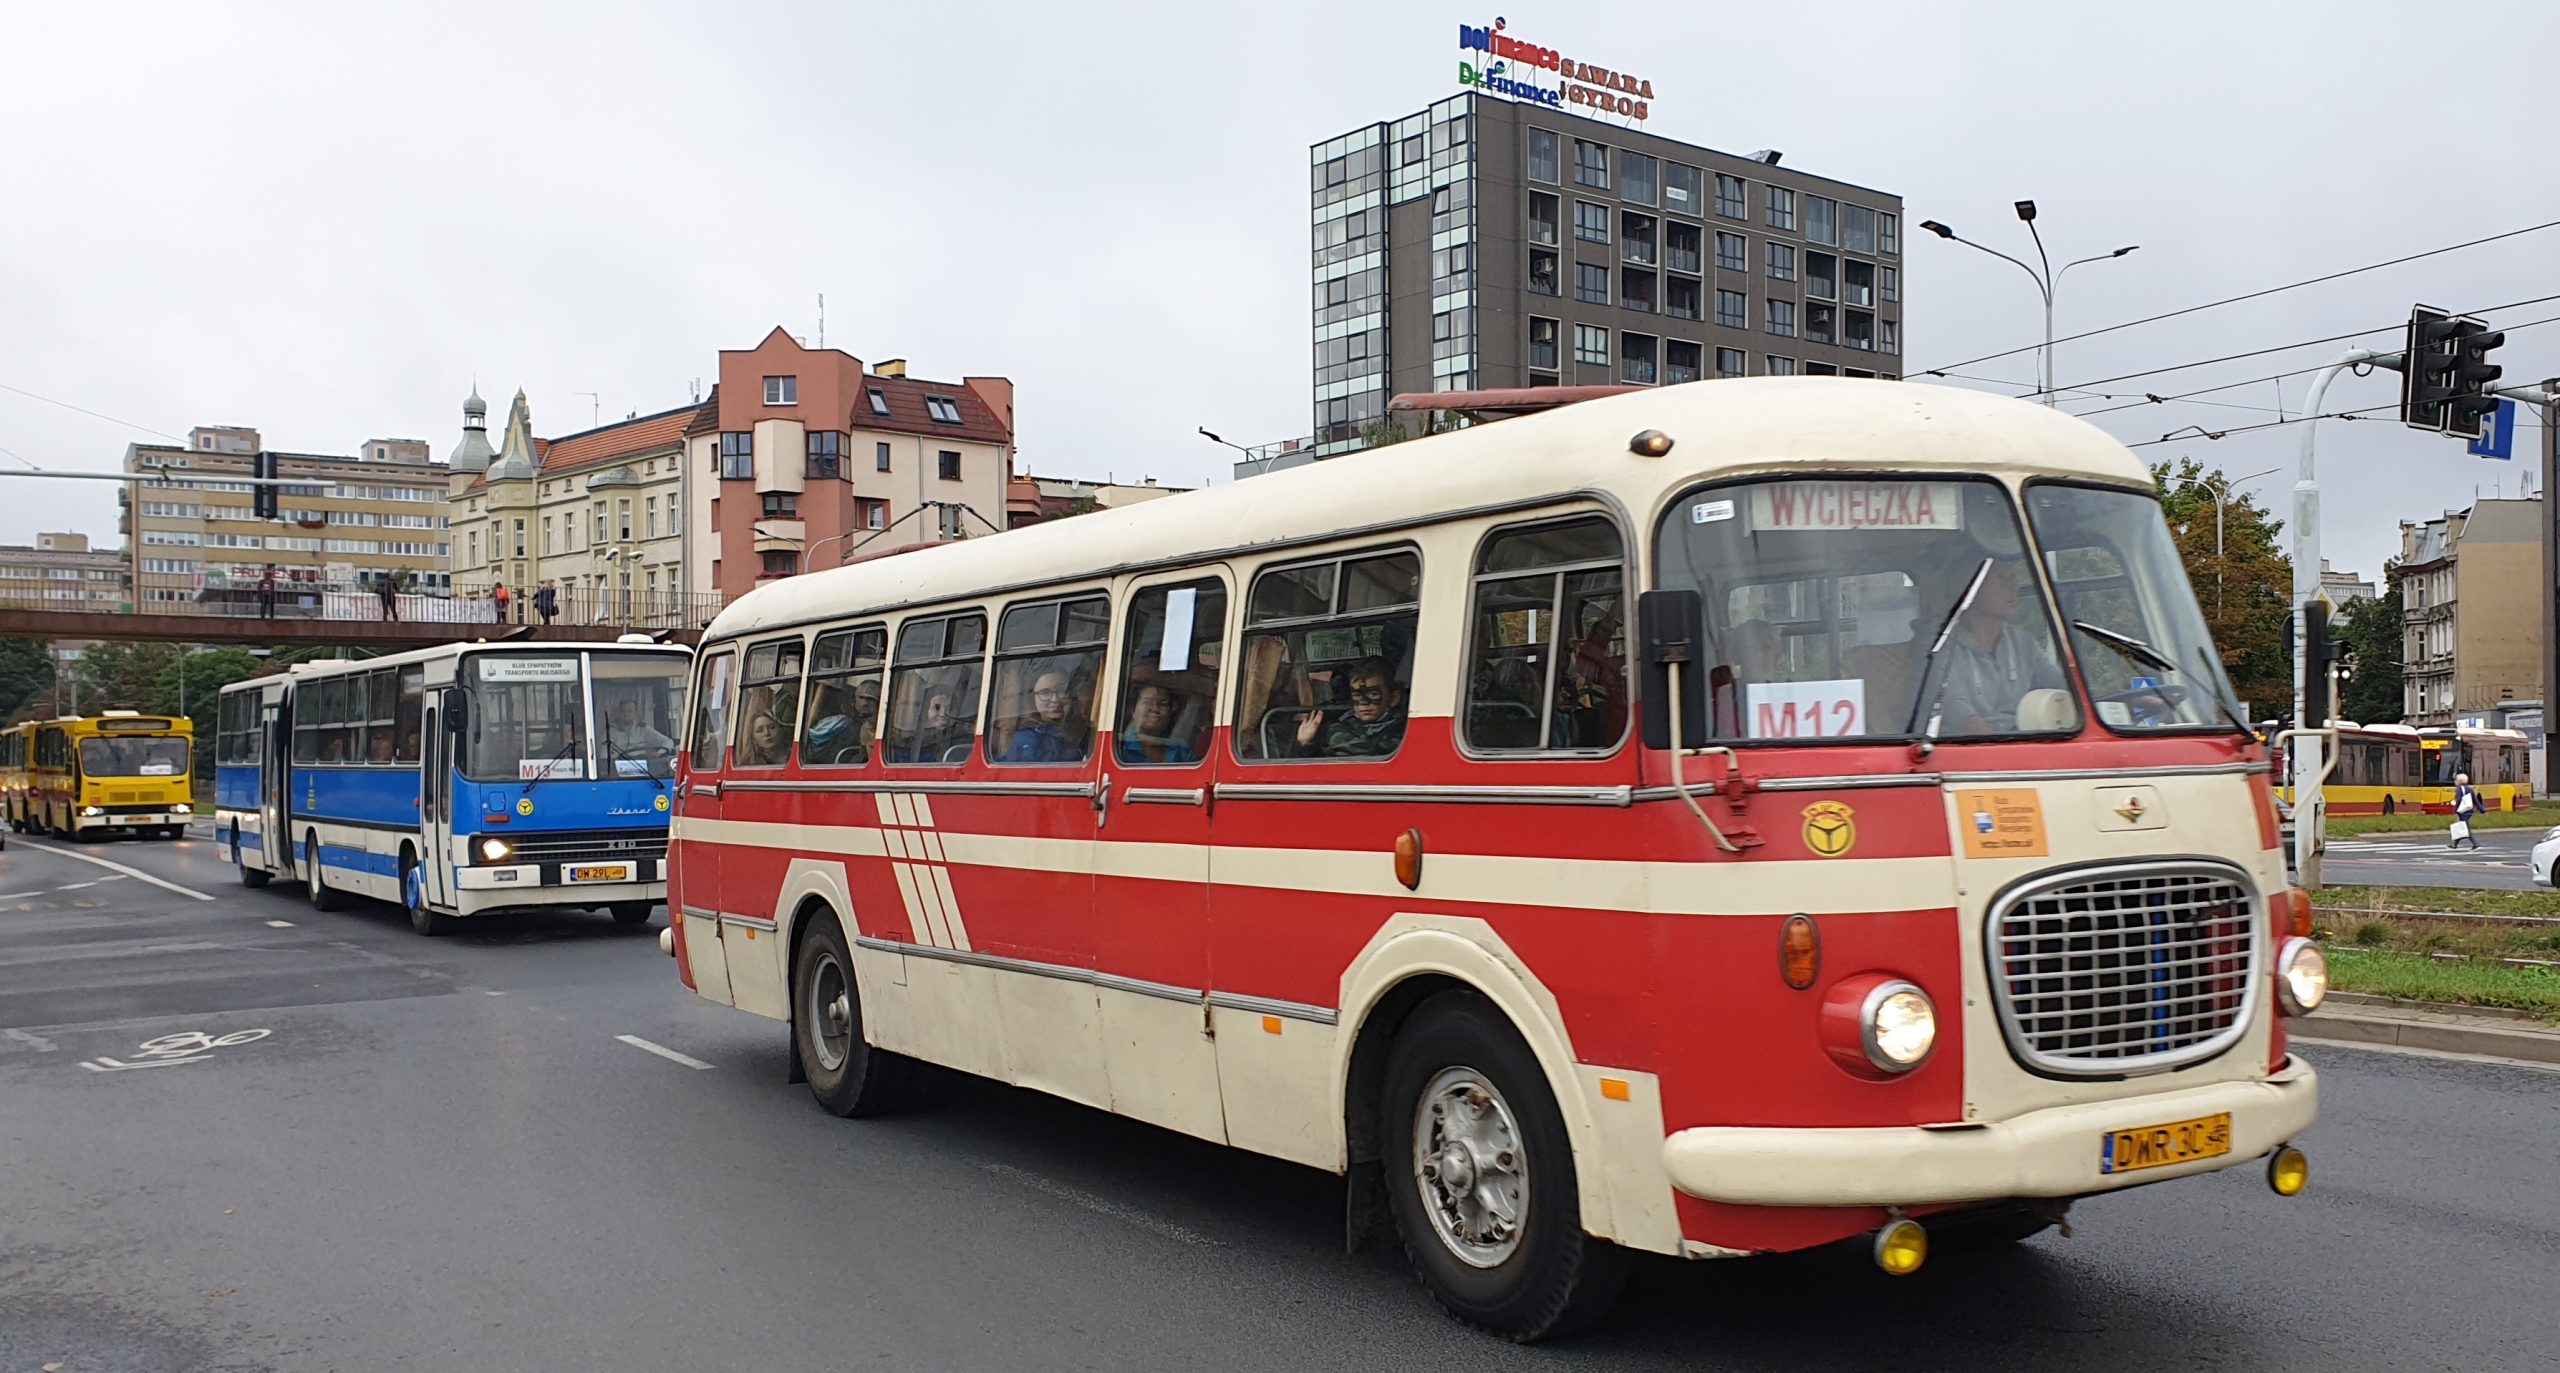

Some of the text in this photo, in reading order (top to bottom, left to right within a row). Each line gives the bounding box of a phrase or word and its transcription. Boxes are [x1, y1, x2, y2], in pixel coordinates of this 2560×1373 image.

[1460, 17, 1559, 71] polfinance
[1561, 58, 1654, 99] SAWARA
[1569, 84, 1648, 120] GYROS
[1769, 483, 1936, 526] WYCIECZKA
[1758, 700, 1856, 737] M12
[2115, 1130, 2170, 1167] DWR
